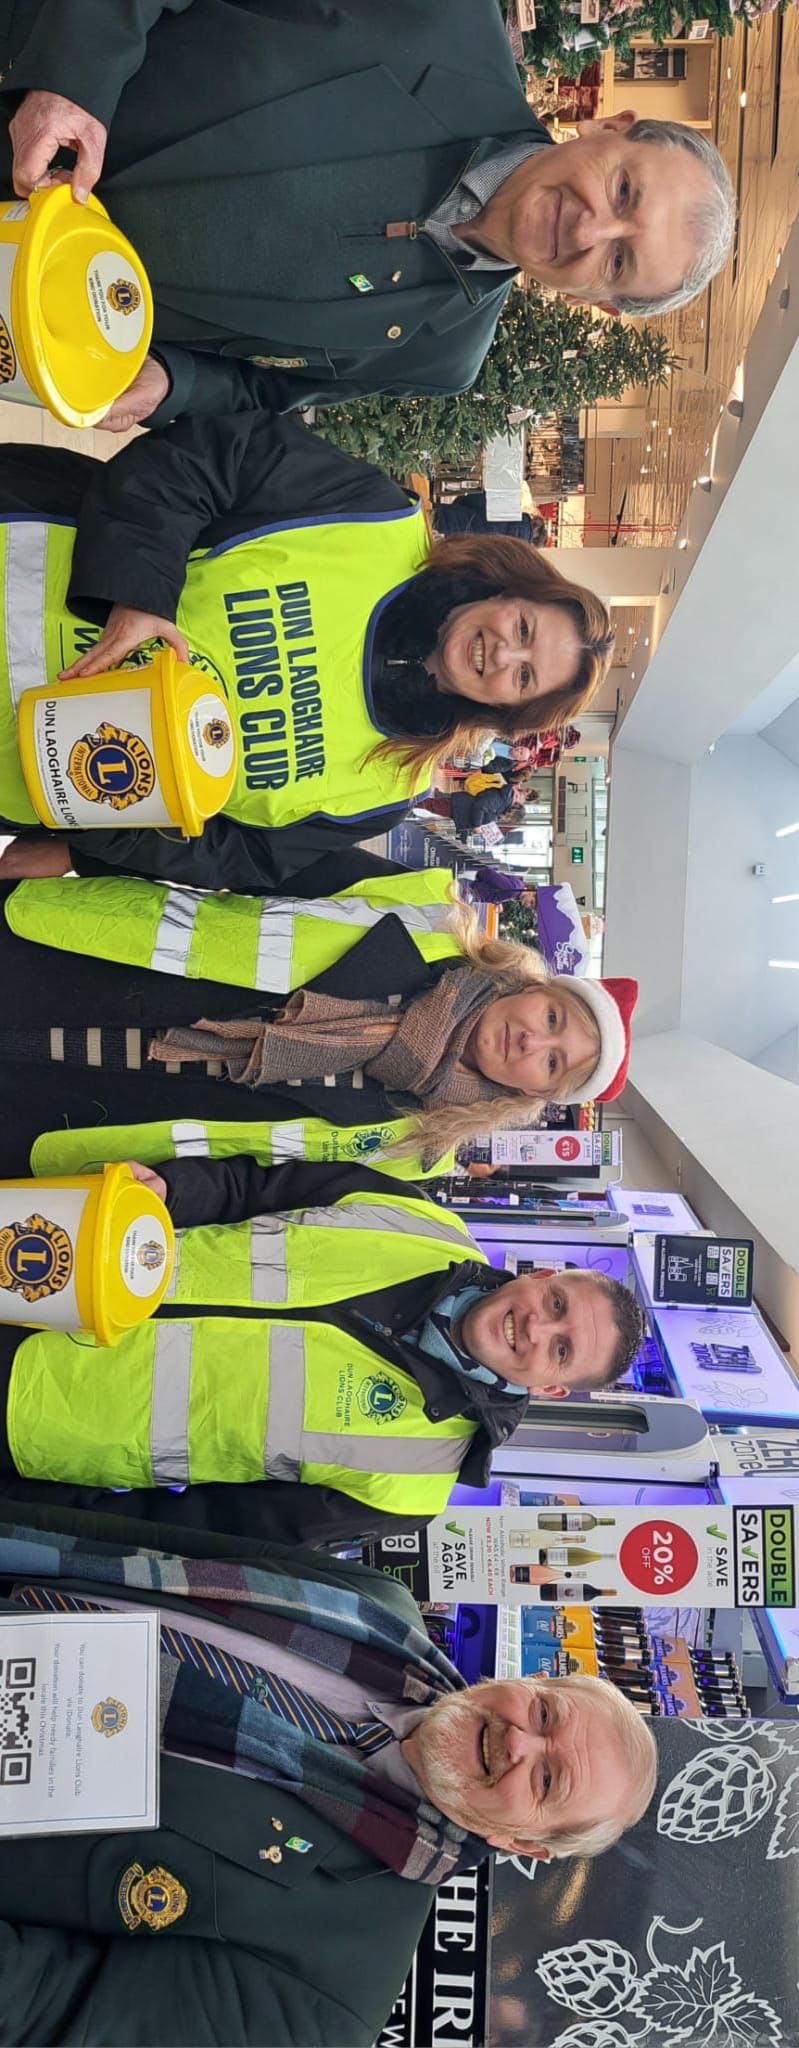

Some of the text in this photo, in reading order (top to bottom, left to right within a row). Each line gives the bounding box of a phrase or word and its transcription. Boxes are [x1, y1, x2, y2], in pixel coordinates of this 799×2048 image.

[223, 588, 290, 791] LIONS CLUB
[276, 581, 326, 782] DUN LAOGHAIRE
[45, 701, 57, 726] DUN
[45, 730, 68, 805] LAOGHAIRE
[73, 746, 94, 798] INTERNATIONAL
[97, 760, 127, 784] L
[130, 740, 151, 794] LIONS
[17, 1249, 46, 1273] L
[52, 1234, 69, 1286] LIONS
[720, 1248, 732, 1296] SAVERS
[736, 1250, 746, 1296] DOUBLE
[336, 1370, 346, 1418] LIONS CLUB
[344, 1381, 353, 1427] LAOGHAIRE
[374, 1392, 392, 1405] L
[731, 1440, 762, 1470] zone
[441, 1542, 454, 1590] AGAIN
[455, 1542, 467, 1580] SAVE
[641, 1547, 650, 1569] OFF
[652, 1530, 674, 1584] 20%
[716, 1547, 728, 1587] SAVE
[741, 1513, 760, 1603] SAVERS
[770, 1514, 788, 1602] DOUBLE
[78, 1697, 83, 1705] to
[147, 1890, 166, 1906] L
[434, 1866, 478, 1952] HE
